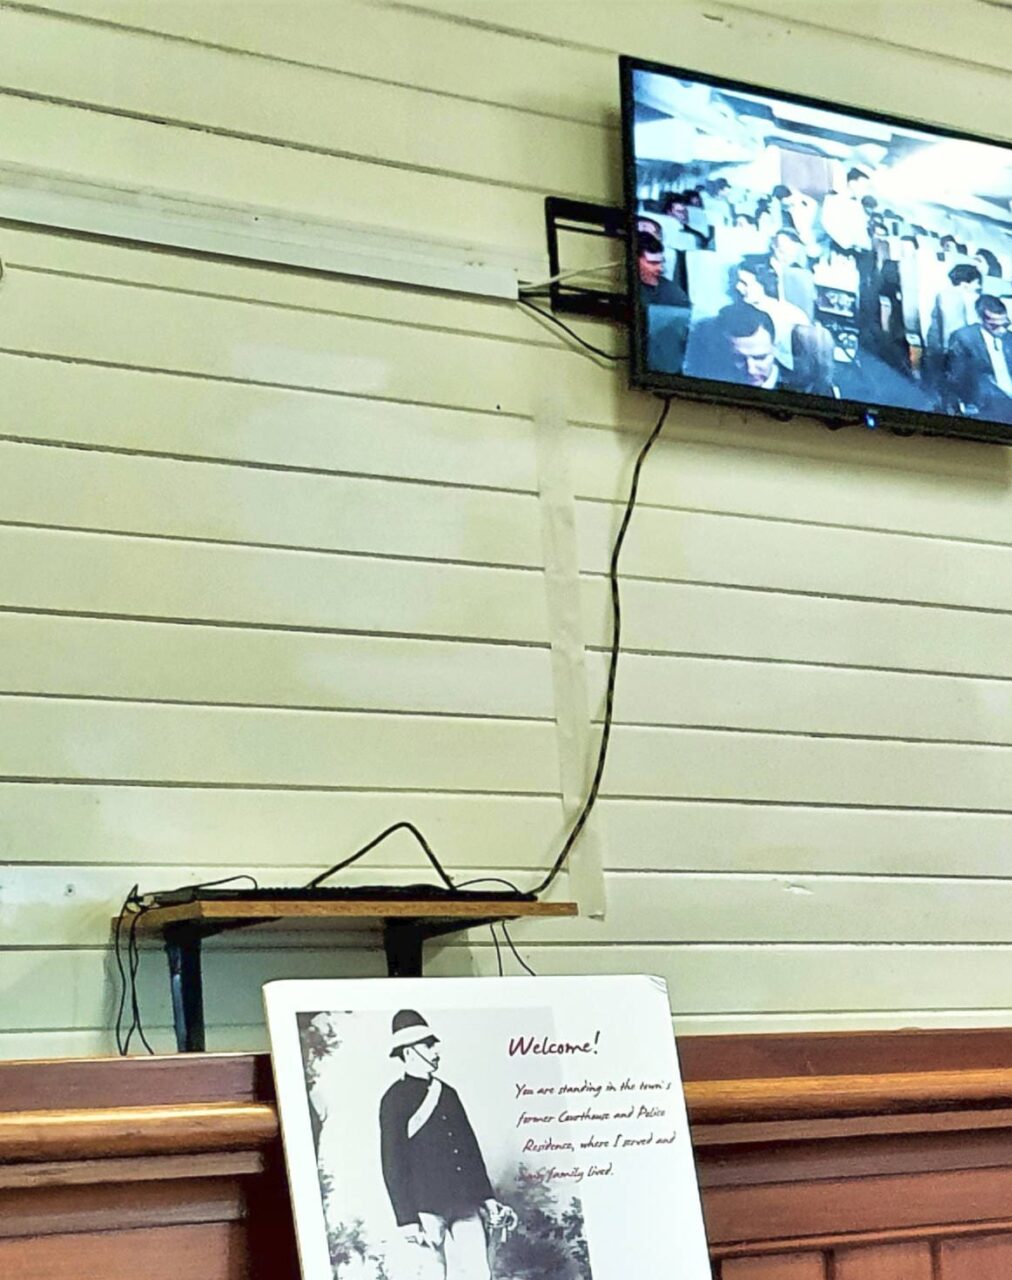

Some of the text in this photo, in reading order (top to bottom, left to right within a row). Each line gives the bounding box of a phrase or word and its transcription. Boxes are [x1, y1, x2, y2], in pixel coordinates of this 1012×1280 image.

[508, 1030, 600, 1056] Welcome!
[515, 1078, 672, 1099] You are standing in the town's
[516, 1105, 666, 1128] former Courthouse and Police
[522, 1131, 677, 1152] Residence, where I served and
[545, 1166, 585, 1184] family
[587, 1162, 615, 1177] lived.
